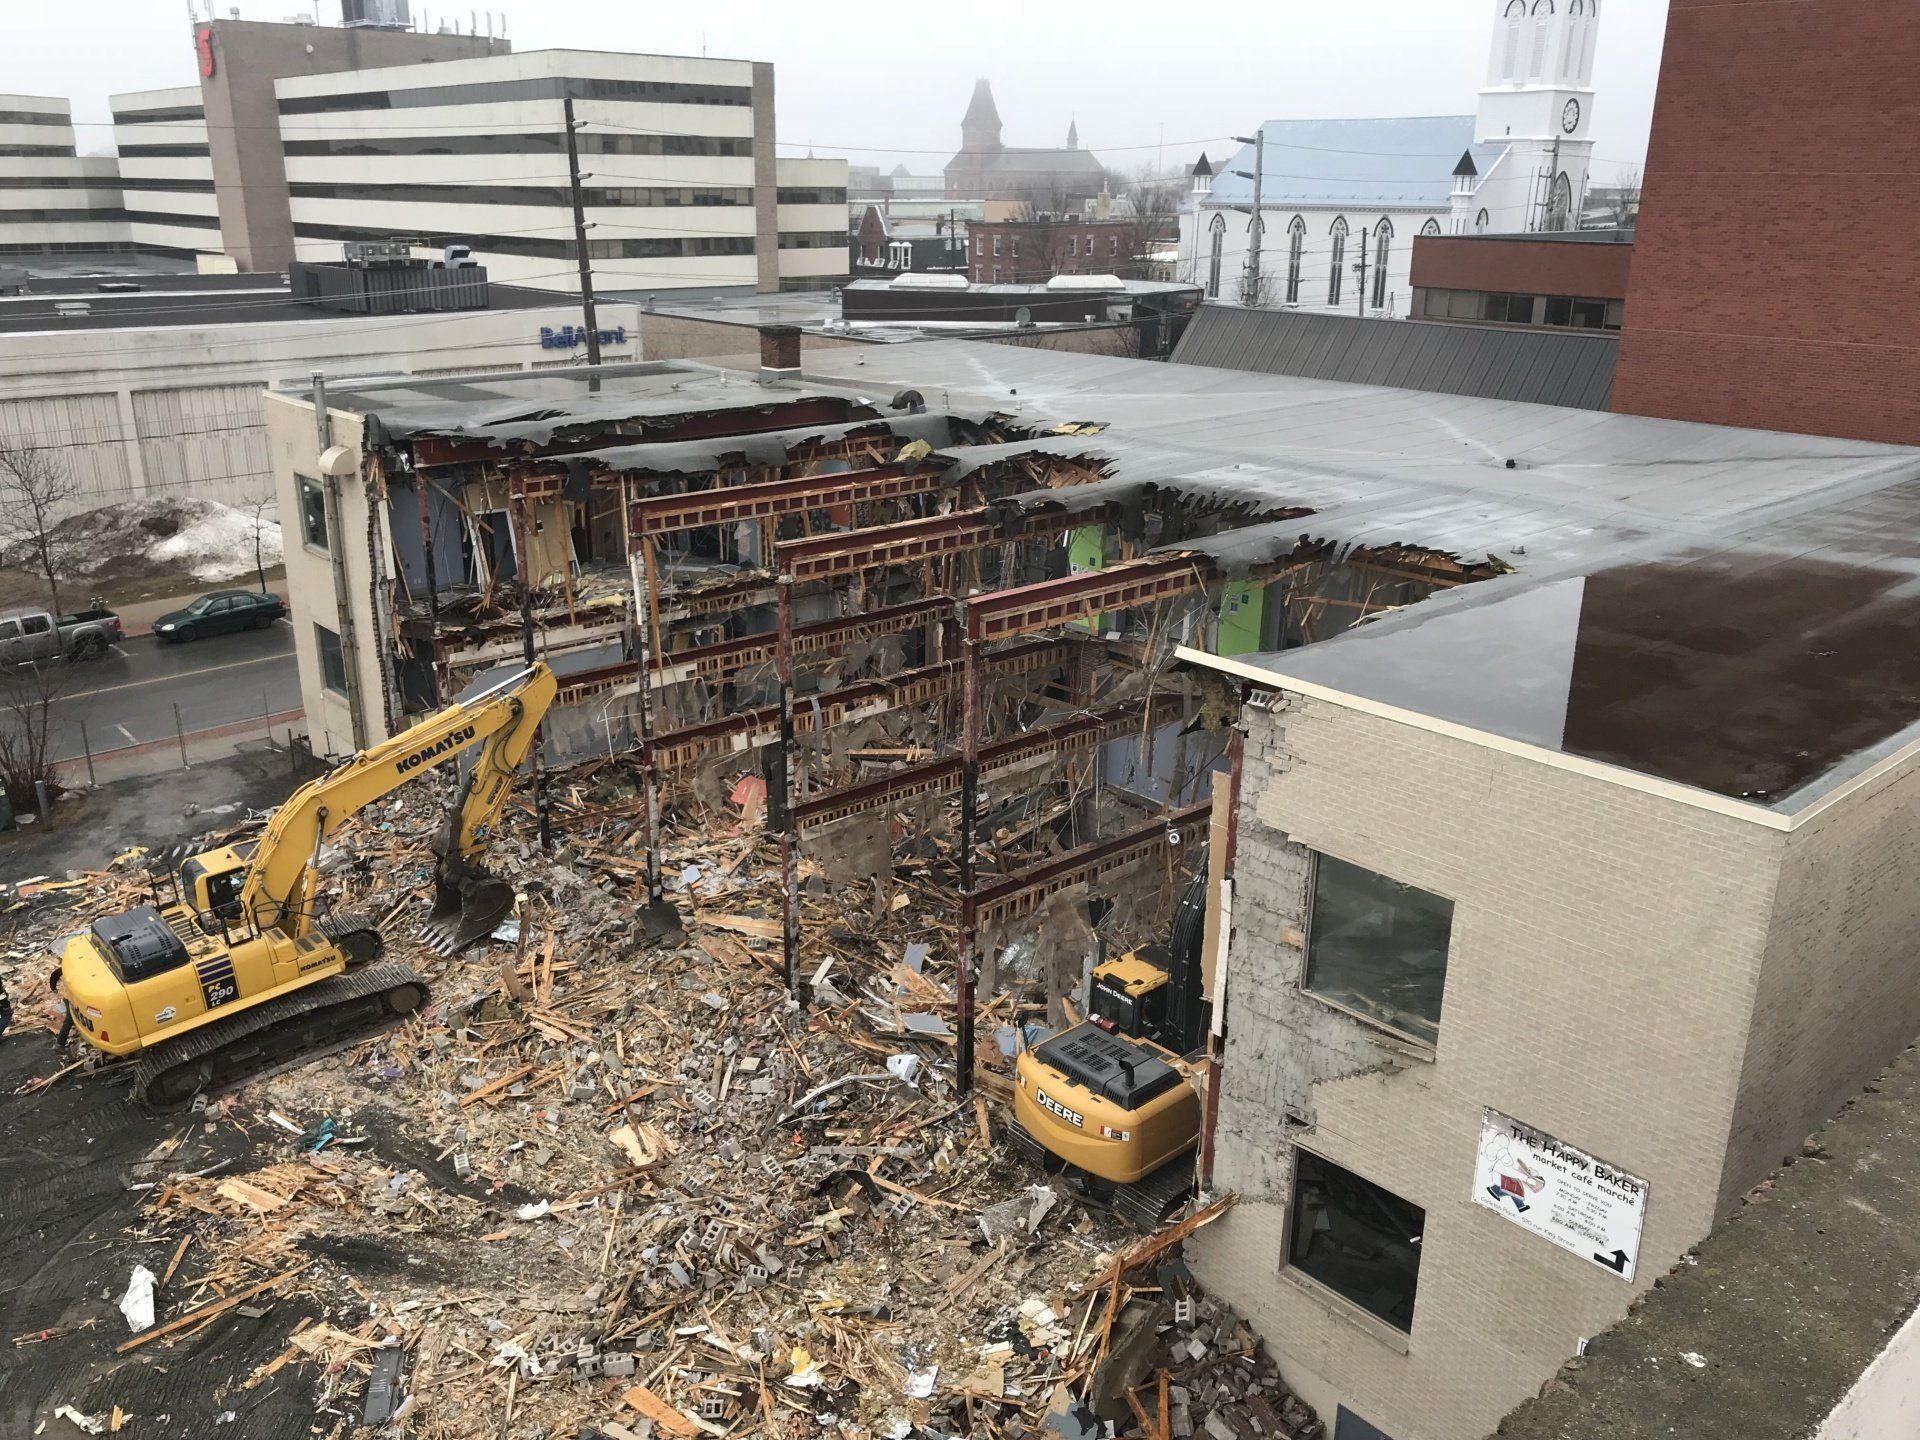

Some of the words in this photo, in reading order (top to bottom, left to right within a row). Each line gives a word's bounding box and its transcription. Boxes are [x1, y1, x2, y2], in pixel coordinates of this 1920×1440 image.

[396, 726, 475, 774] KOMATSU
[300, 955, 336, 972] KOMATSU
[208, 983, 221, 993] PC
[210, 986, 234, 1001] 290
[1096, 982, 1112, 995] JOHN
[1113, 991, 1133, 1006] DEERE
[1036, 1087, 1083, 1128] DEERE
[1510, 1125, 1538, 1148] THE
[1543, 1141, 1588, 1170] HAPPY
[1594, 1165, 1639, 1197] BAKER
[1533, 1153, 1567, 1173] market
[1571, 1172, 1593, 1186] café
[1597, 1184, 1635, 1207] marché
[1557, 1179, 1572, 1189] OPEN
[1559, 1188, 1581, 1201] MONDAY
[1588, 1201, 1608, 1214] FRIDAY
[1568, 1206, 1594, 1221] SATURDAY
